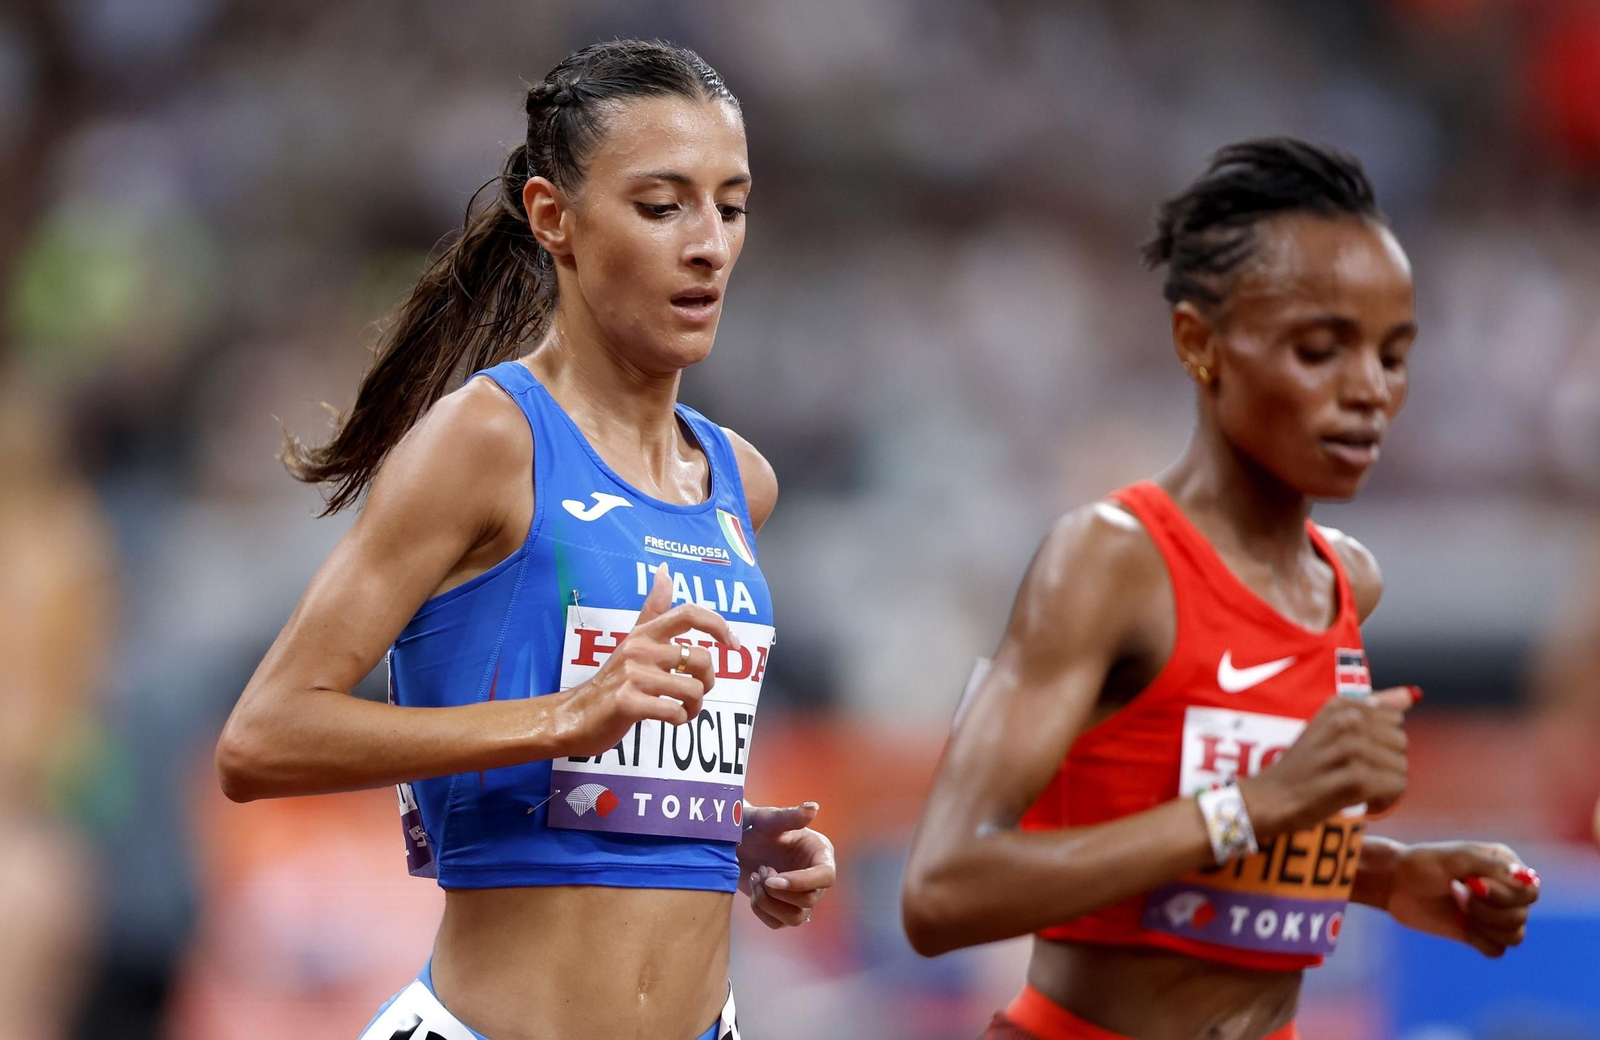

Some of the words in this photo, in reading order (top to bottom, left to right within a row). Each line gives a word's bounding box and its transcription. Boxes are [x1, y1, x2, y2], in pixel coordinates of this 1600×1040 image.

[644, 535, 730, 559] FRECCIAROSSA
[633, 791, 743, 827] TOKYO
[1229, 904, 1344, 946] TOKYO
